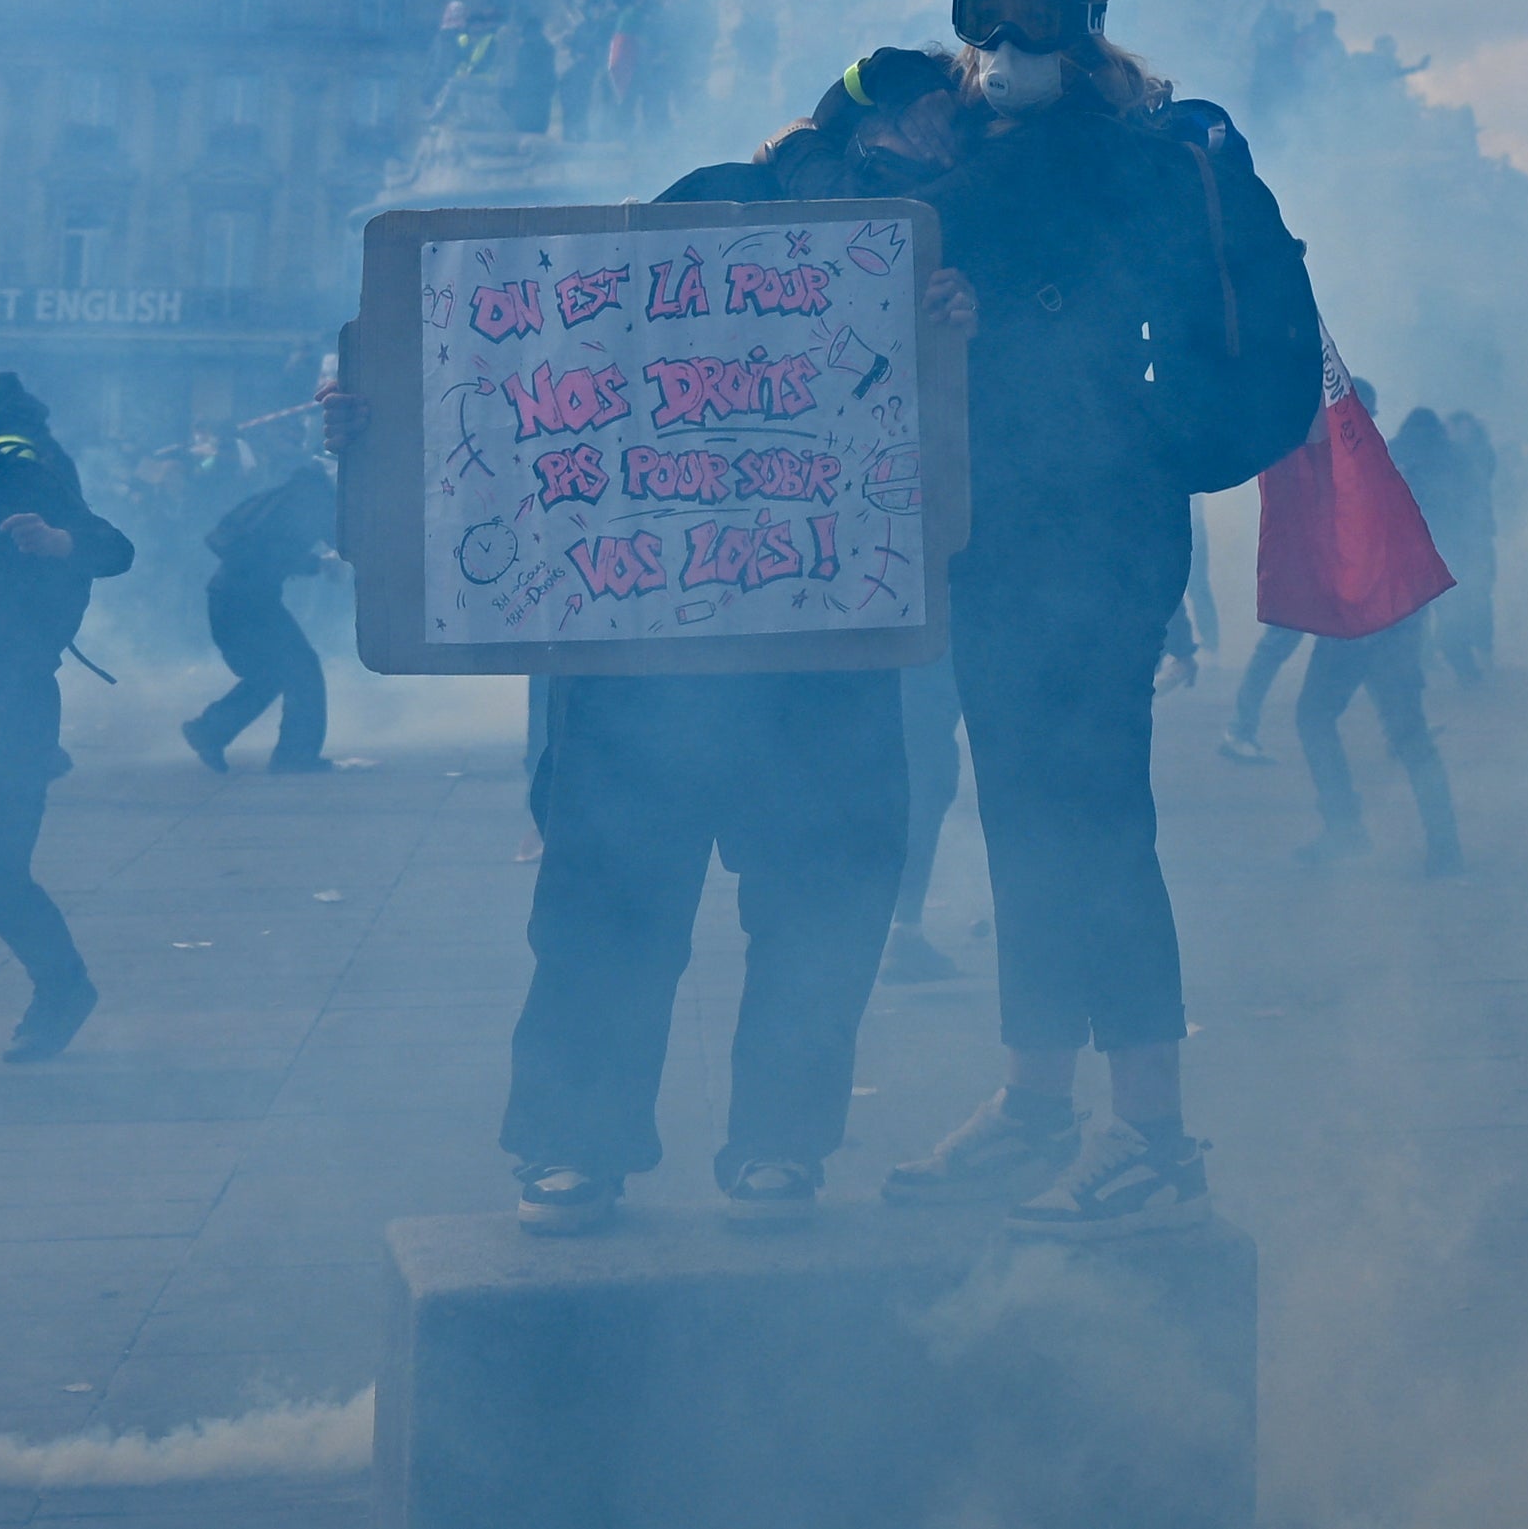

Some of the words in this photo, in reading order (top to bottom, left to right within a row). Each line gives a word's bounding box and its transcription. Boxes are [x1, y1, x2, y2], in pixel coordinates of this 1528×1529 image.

[35, 288, 183, 323] ENGLISH
[470, 280, 545, 344] ON
[555, 263, 631, 330] EST
[646, 245, 710, 323] LÀ
[725, 263, 834, 316] POUR
[501, 360, 632, 443] NOS
[532, 442, 610, 513] PAS
[620, 445, 731, 506] POUR
[564, 528, 668, 601] VOS
[807, 510, 841, 582] !
